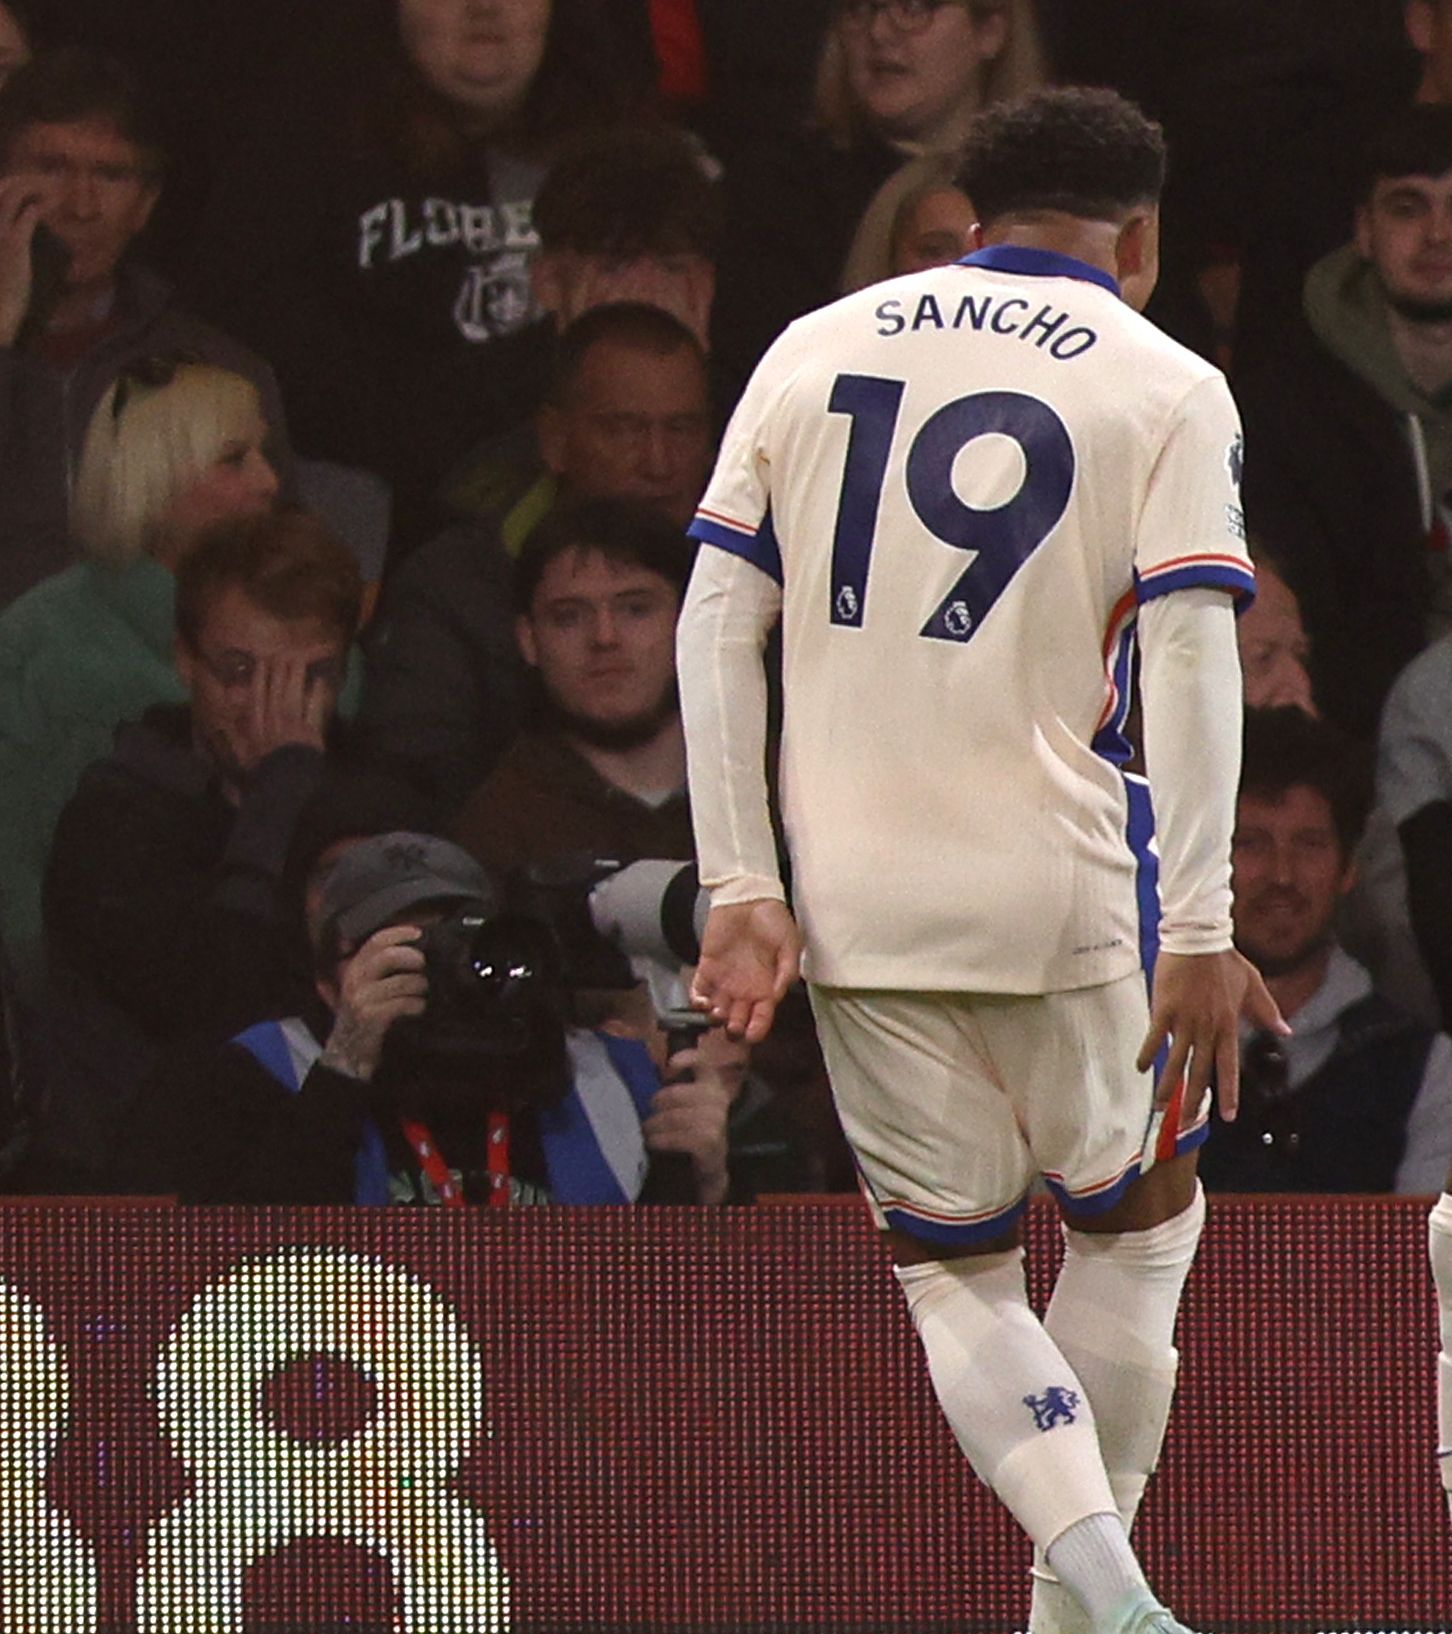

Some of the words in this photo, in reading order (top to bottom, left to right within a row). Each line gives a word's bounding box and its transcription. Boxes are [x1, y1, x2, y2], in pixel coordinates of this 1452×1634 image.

[875, 294, 1096, 361] SANCHO
[827, 373, 1076, 643] 19
[0, 1246, 512, 1634] 8
